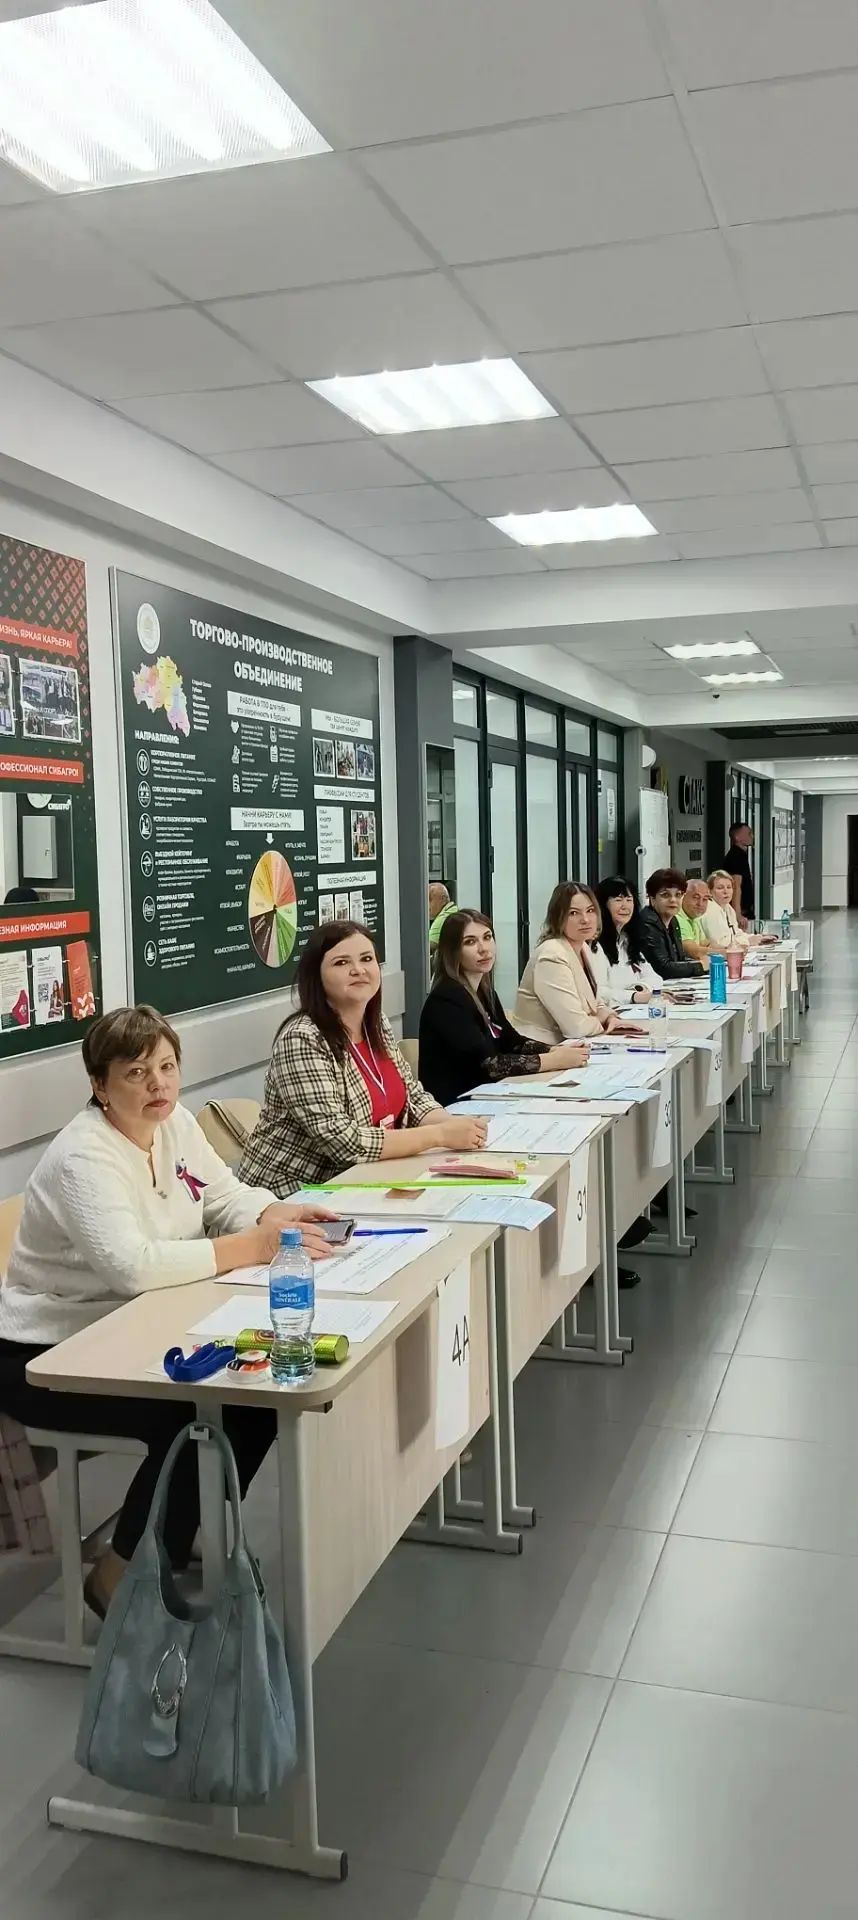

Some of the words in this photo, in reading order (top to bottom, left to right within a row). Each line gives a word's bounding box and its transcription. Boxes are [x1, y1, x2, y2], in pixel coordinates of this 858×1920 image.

[20, 629, 41, 641] ЯРКАЯ
[42, 634, 72, 649] КАРЬЕРА!
[190, 619, 333, 675] ТОРГОВО-ПРОИЗВОДСТВЕННОЕ
[234, 661, 303, 692] ОБЪЕДИНЕНИЕ
[240, 696, 257, 706] РАБОТА
[0, 761, 47, 775] ОФЕССИОНАЛ
[48, 766, 79, 777] СИБАГРО!
[20, 920, 67, 933] ИНФОРМАЦИЯ
[576, 1184, 588, 1222] 31
